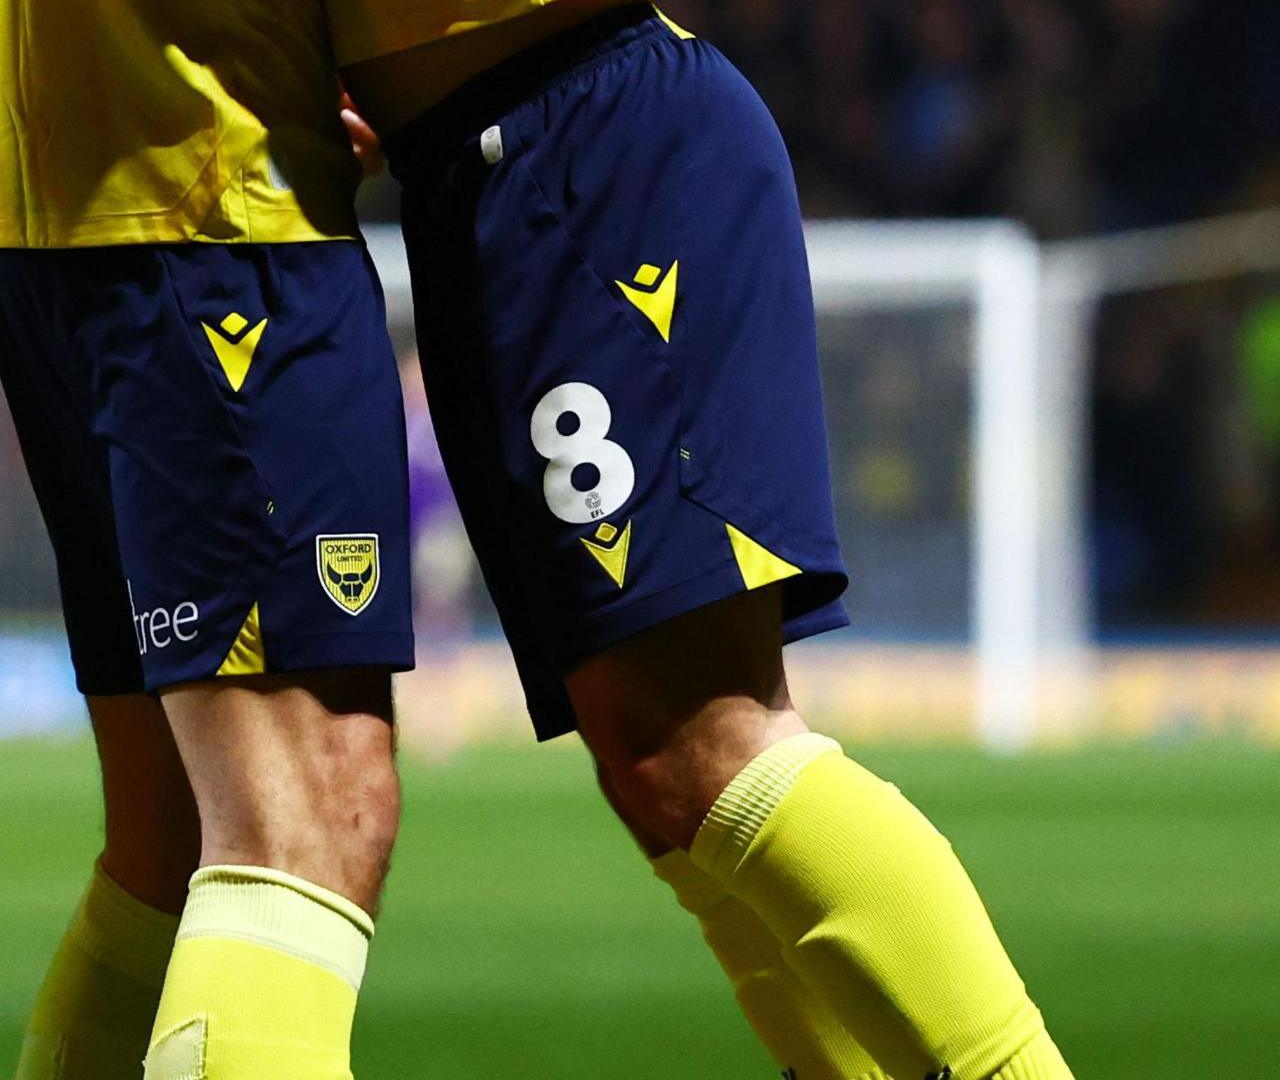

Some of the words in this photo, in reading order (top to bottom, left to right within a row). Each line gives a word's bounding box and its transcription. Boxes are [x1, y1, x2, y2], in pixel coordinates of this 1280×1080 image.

[530, 381, 635, 524] 8
[325, 543, 371, 555] OXFORD
[337, 555, 363, 563] UNITED
